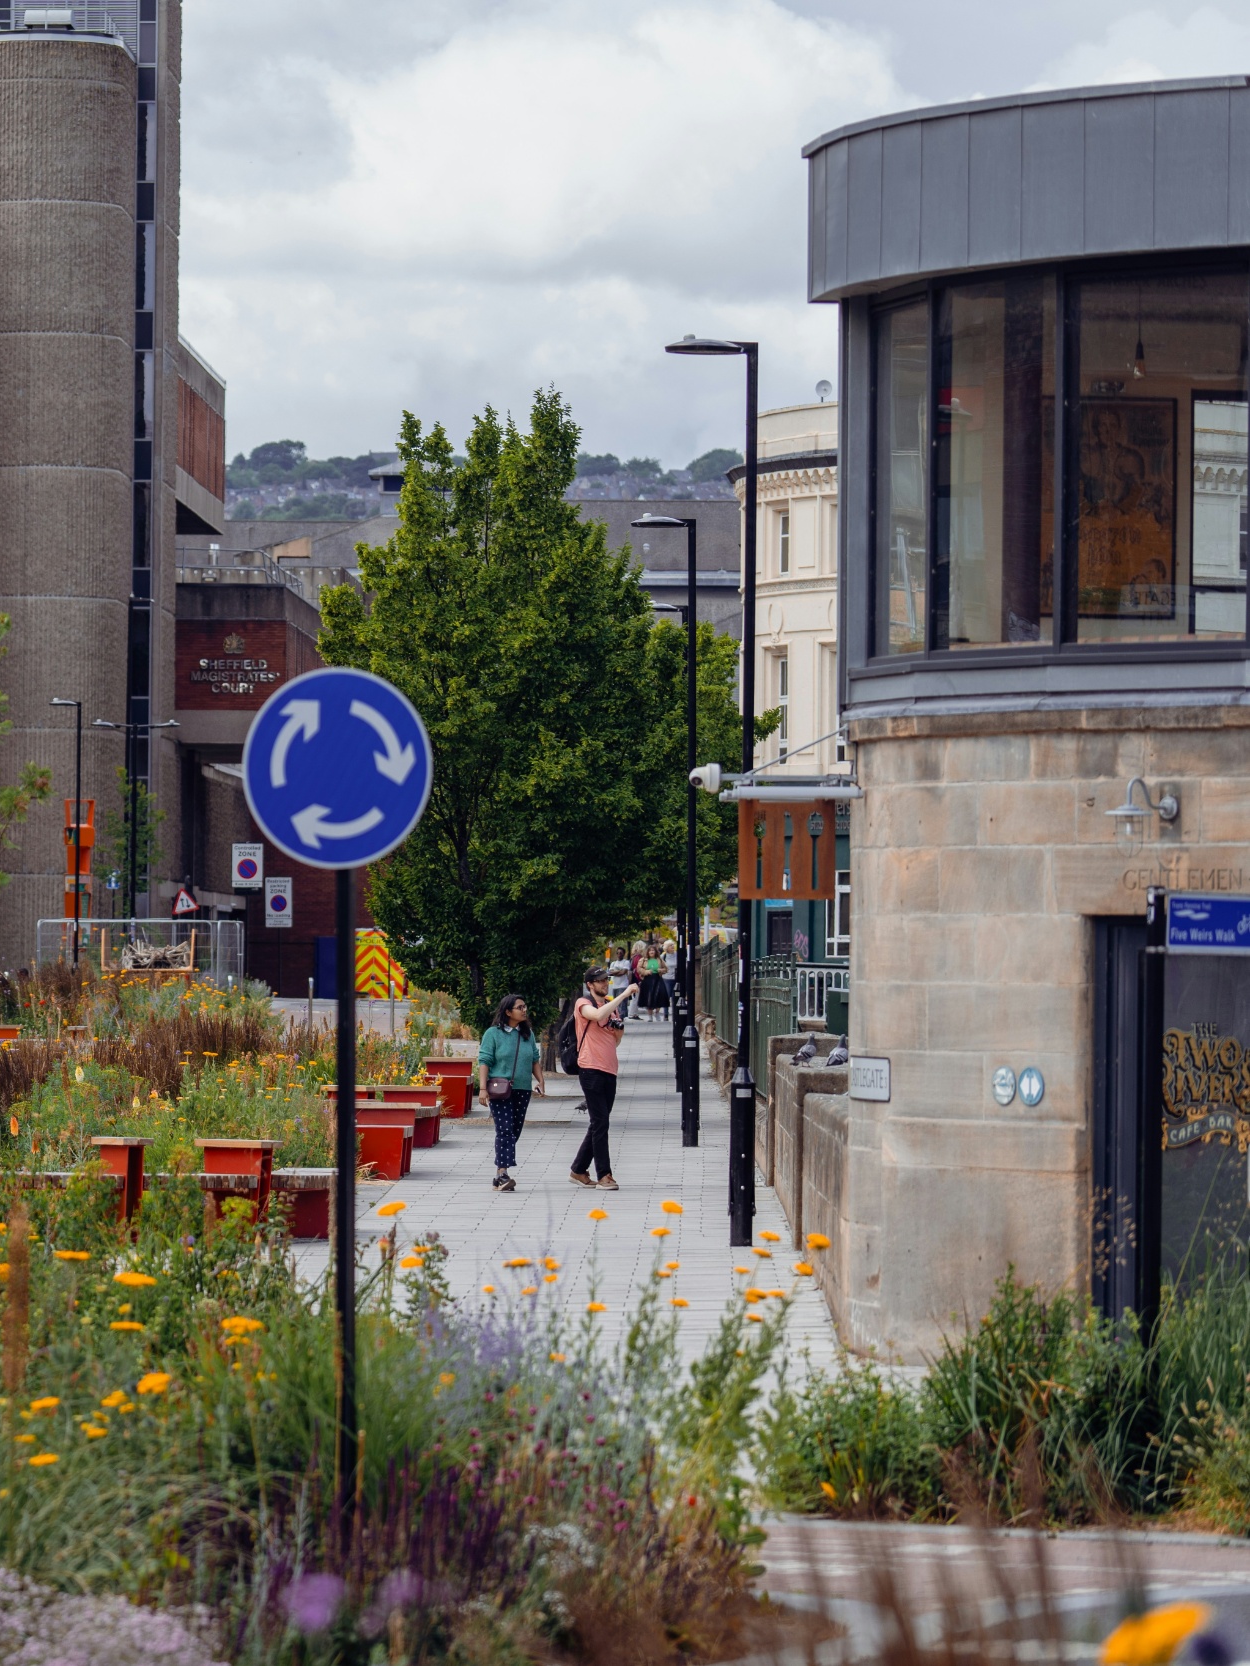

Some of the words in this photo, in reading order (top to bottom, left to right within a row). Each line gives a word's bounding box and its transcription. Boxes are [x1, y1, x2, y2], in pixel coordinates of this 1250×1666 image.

[199, 659, 268, 670] SHEFFIELD
[211, 683, 256, 694] COURT
[1170, 927, 1188, 941] Five
[1190, 928, 1213, 942] Weirs
[1215, 928, 1236, 943] Walk
[1191, 1022, 1218, 1037] THE
[1163, 1028, 1242, 1076] TWO
[1169, 1122, 1200, 1143] CAFE
[1208, 1115, 1233, 1129] BAR
